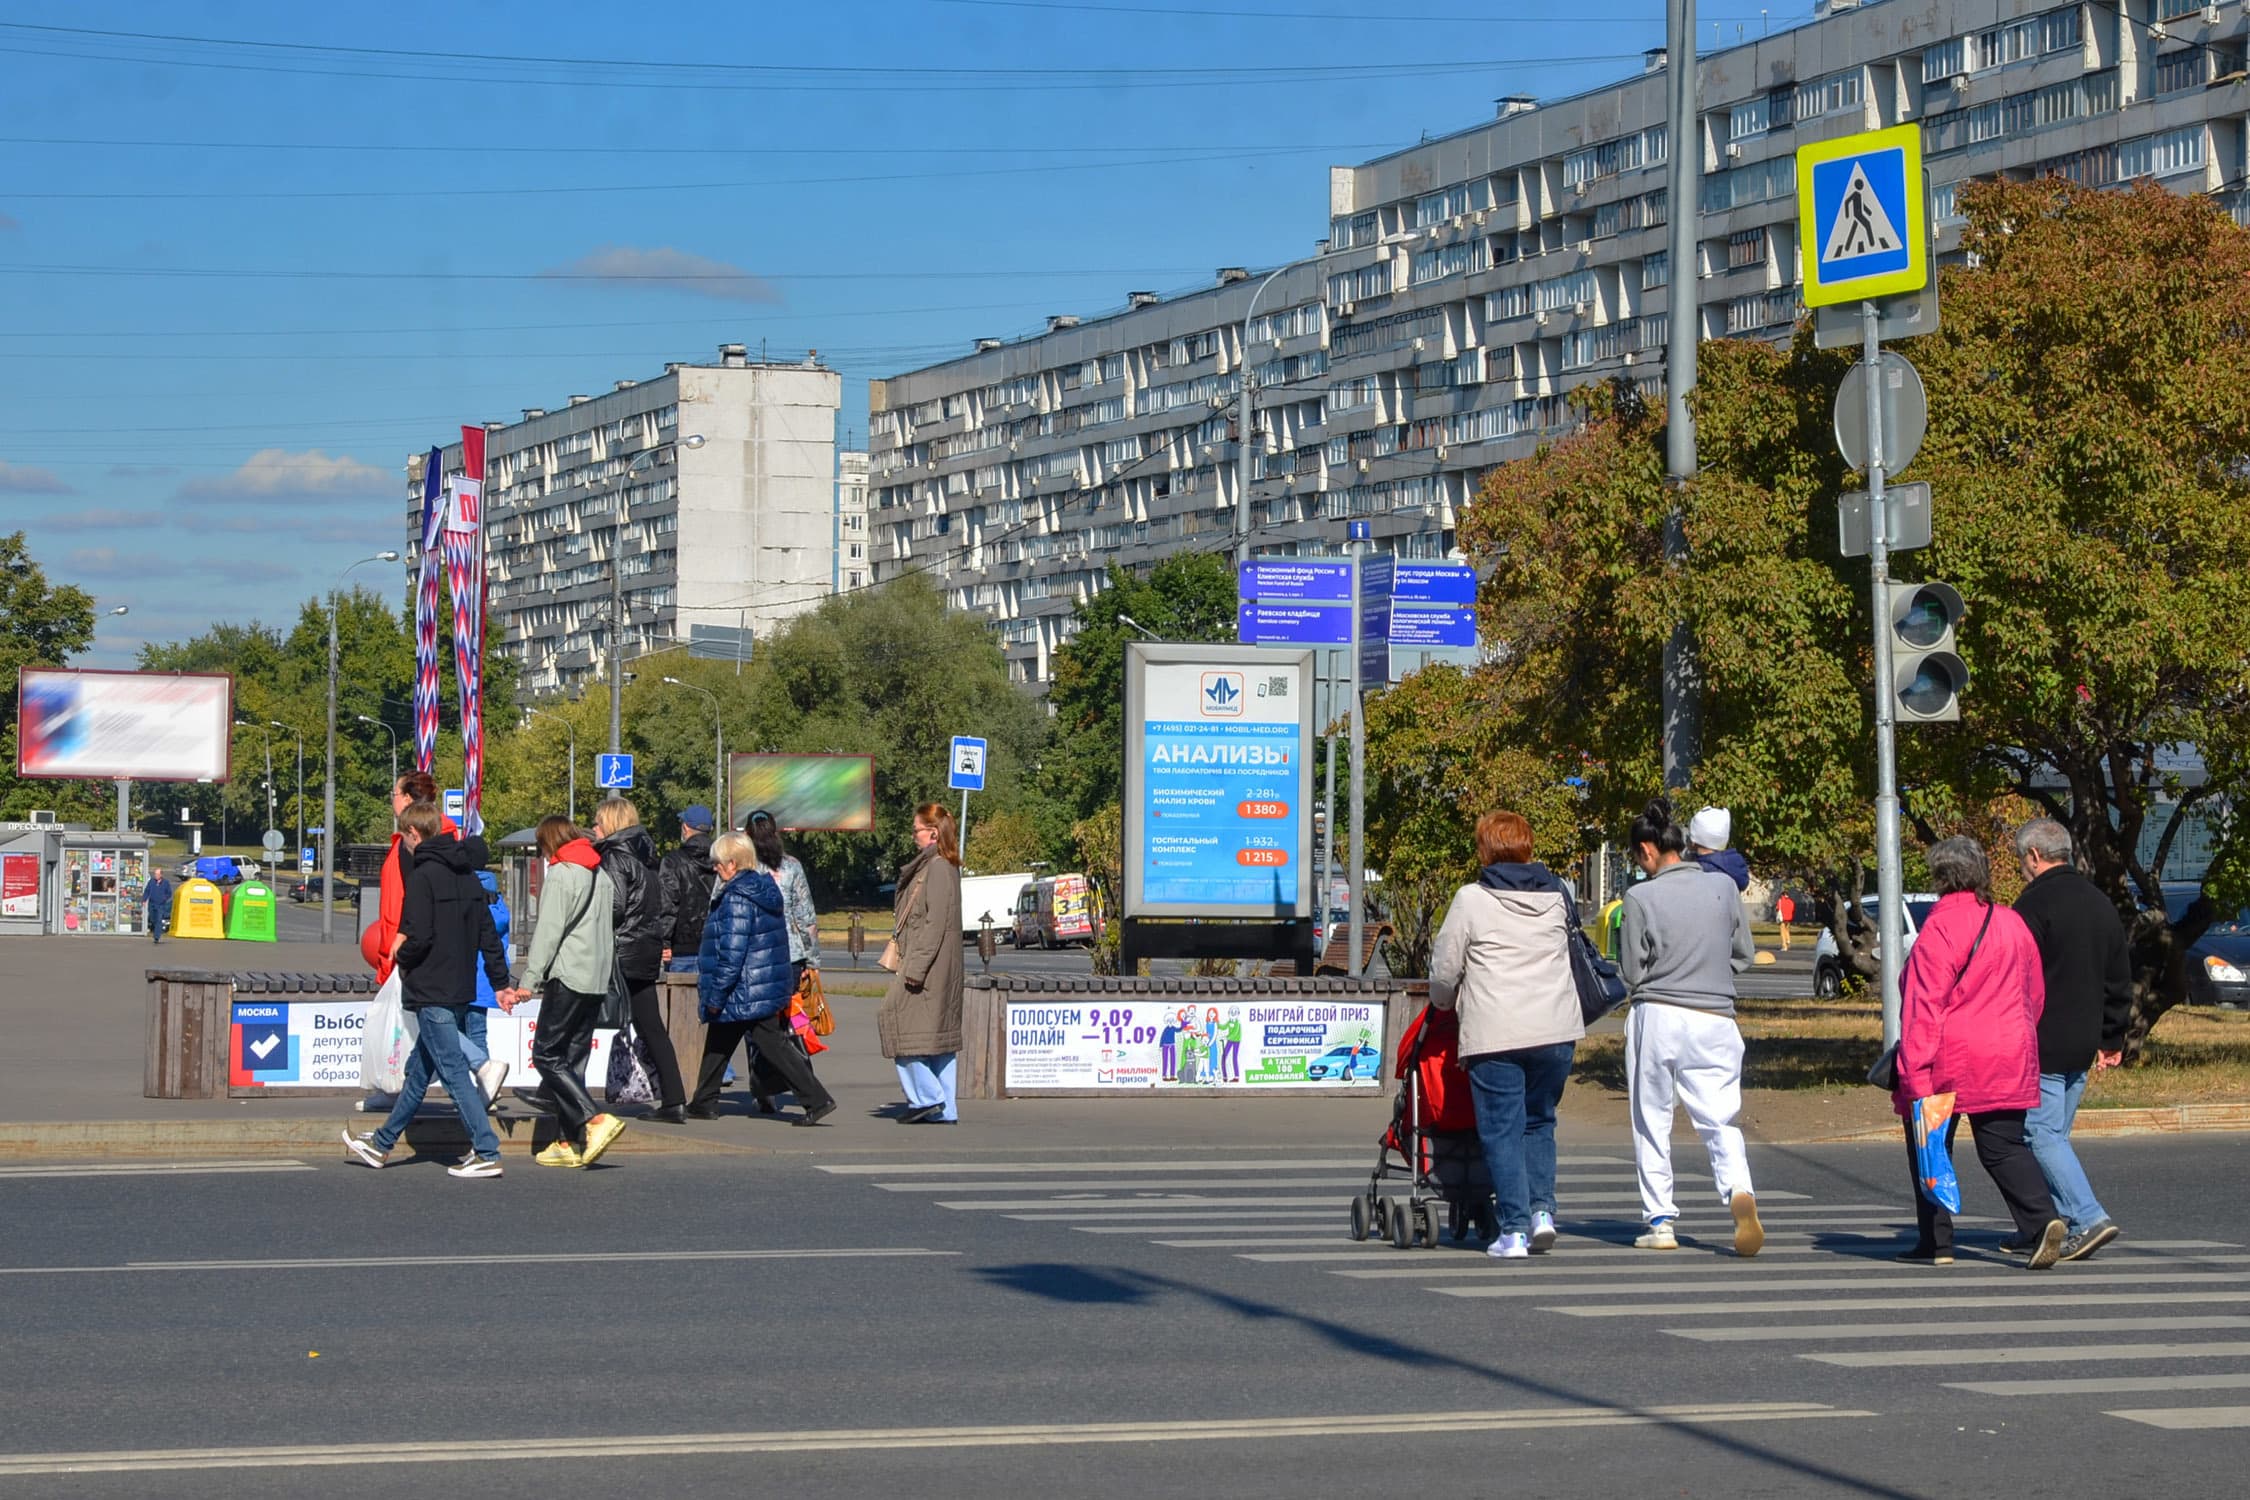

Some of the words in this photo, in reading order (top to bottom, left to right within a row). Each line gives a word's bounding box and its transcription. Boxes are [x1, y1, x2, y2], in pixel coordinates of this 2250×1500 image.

[1152, 744, 1290, 765] АНАЛИЗЫ
[1237, 769, 1290, 777] ПОСРЕДНИКОВ
[1153, 788, 1225, 797] БИОХИМИЧЕСКИЙ
[1188, 798, 1216, 806] КРОВИ
[8, 822, 42, 831] ПРЕССА
[1152, 836, 1218, 845] ГОСПИТАЛЬНЫЙ
[1152, 846, 1197, 854] КОМПЛЕКС
[238, 1008, 279, 1017] МОСКВА
[1249, 1006, 1304, 1022] ВЫИГРАЙ
[1308, 1005, 1337, 1021] СВОЙ
[1341, 1007, 1370, 1021] ПРИЗ
[314, 1013, 366, 1030] Выбо
[1011, 1009, 1081, 1026] ГОЛОСУЕМ
[1089, 1009, 1133, 1027] 9.09
[1267, 1024, 1324, 1035] ПОДАРОЧНЫЙ
[1011, 1026, 1065, 1046] ОНЛАЙН
[1267, 1036, 1321, 1045] СЕРТИФИКАТ
[1249, 1072, 1305, 1081] АВТОМОБИЛЕЙ
